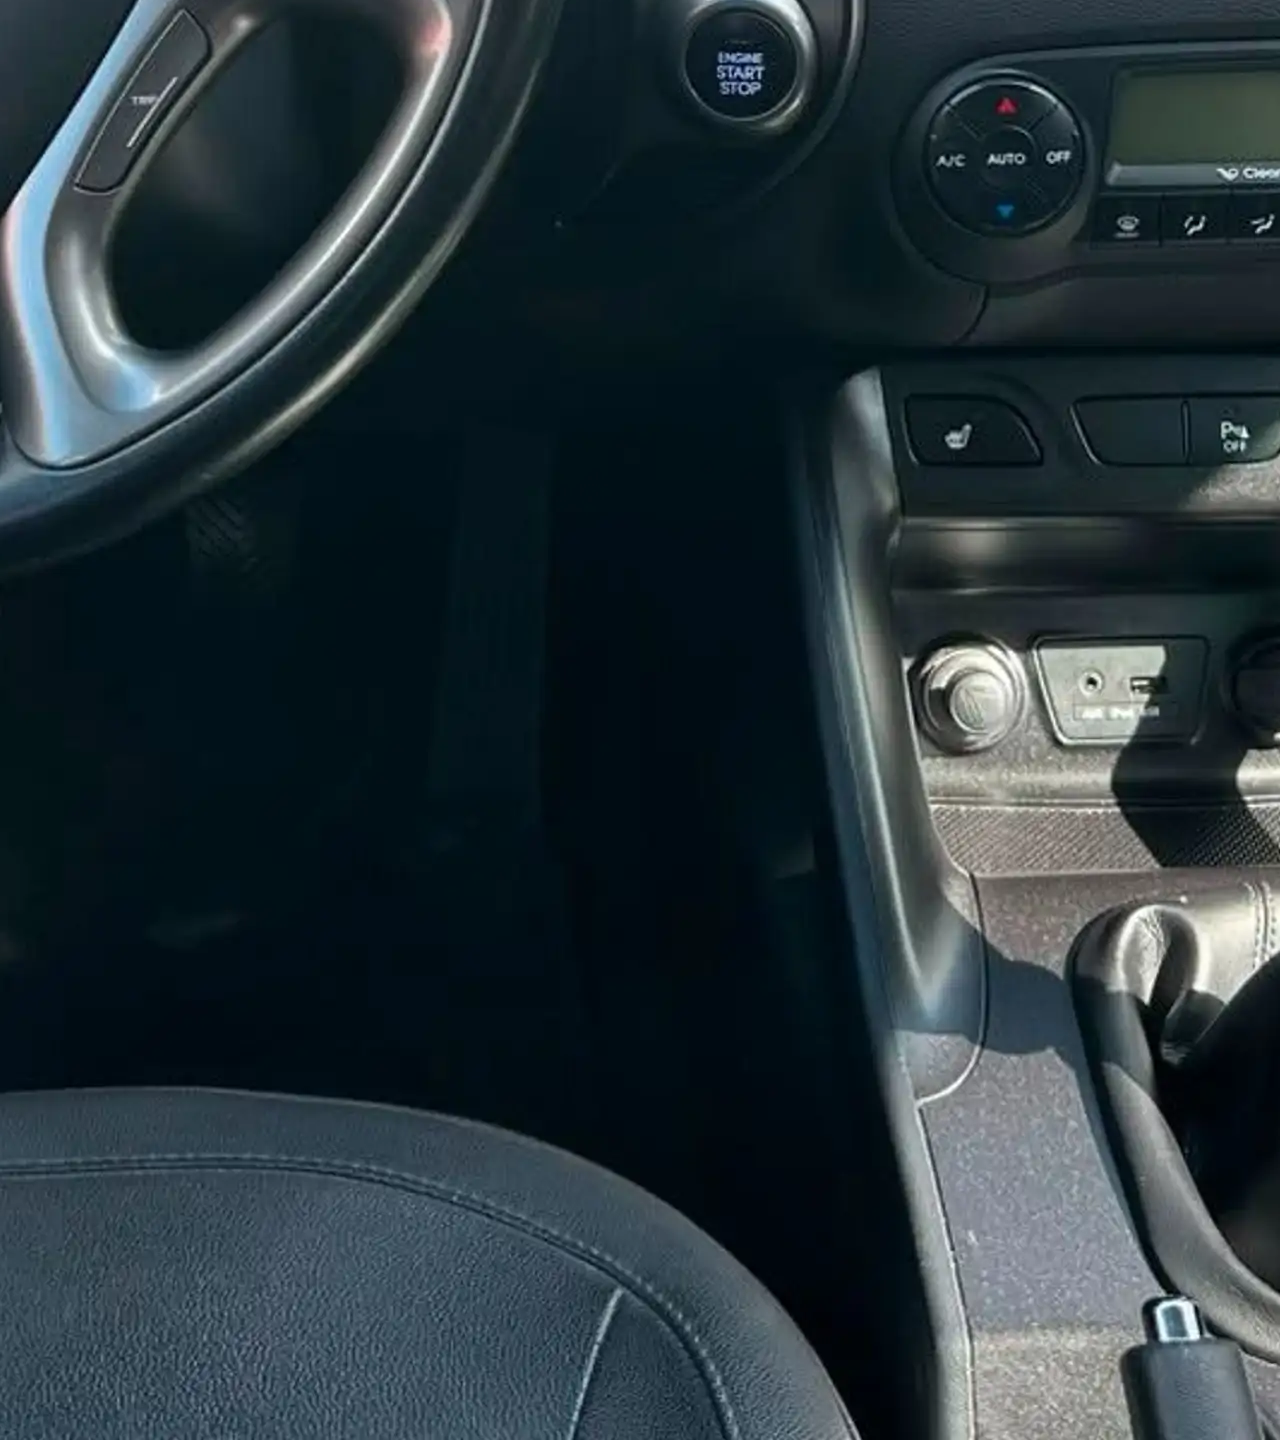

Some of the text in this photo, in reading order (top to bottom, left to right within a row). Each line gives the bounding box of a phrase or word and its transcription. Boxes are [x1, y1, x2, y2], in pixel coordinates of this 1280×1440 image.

[718, 52, 764, 64] ENGINE
[716, 65, 765, 80] START
[720, 82, 762, 95] STOP
[936, 154, 966, 168] A/C
[987, 153, 1027, 166] AUTO
[1045, 150, 1072, 165] OFF
